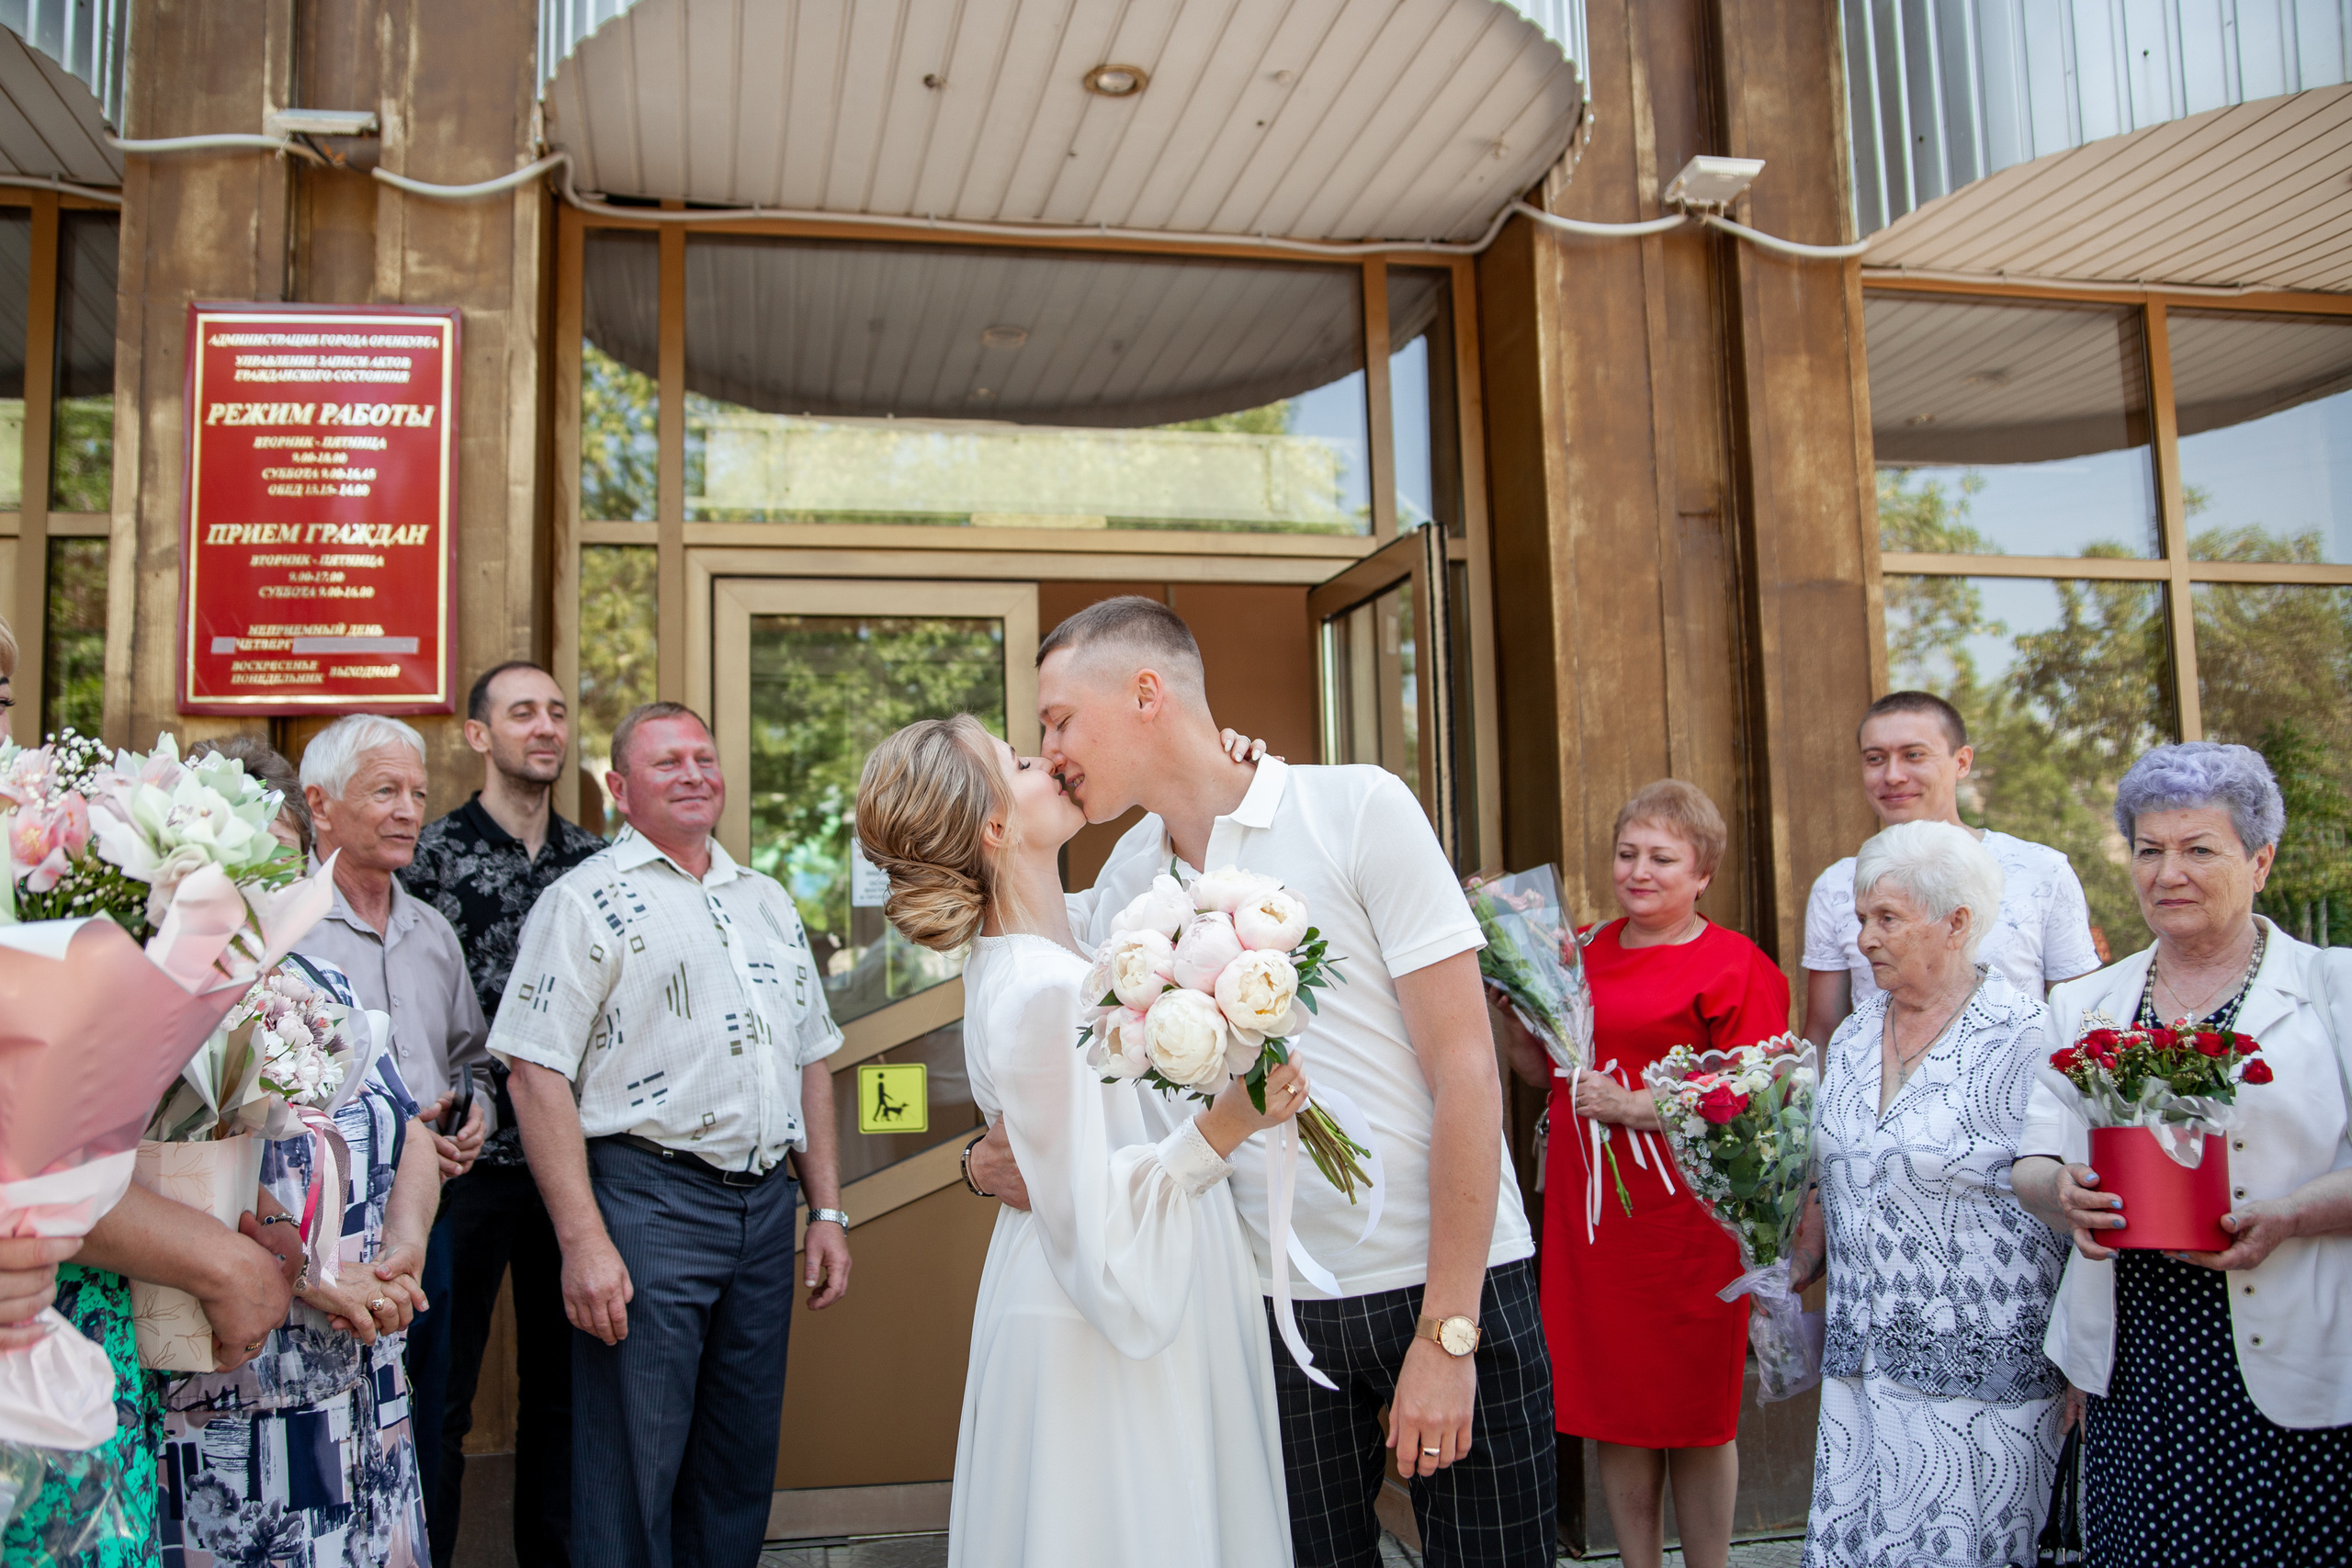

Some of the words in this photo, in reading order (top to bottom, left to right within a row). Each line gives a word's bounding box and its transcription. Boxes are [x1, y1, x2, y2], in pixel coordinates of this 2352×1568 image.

[208, 333, 319, 347] АДМИНИСТРАЦИЯ
[320, 334, 368, 347] ГОРОДА
[368, 334, 439, 348] ОРЕНБУРГА
[235, 355, 317, 367] УПРАВЛЕНИЕ
[318, 355, 369, 368] ЗАПИСИ
[369, 356, 412, 369] АКТОВ
[234, 369, 333, 382] ГРАЖДАНСКОГО
[334, 369, 411, 383] СОСТОЯНИЯ
[206, 402, 315, 426] РЕЖИМ
[318, 403, 435, 427] РАБОТЫ
[253, 436, 315, 449] ВТОРНИК
[322, 436, 387, 450] ПЯТНИЦА
[262, 468, 319, 480] СУББОТА
[267, 483, 303, 496] ОБЕД
[205, 524, 302, 545] ПРИЕМ
[303, 524, 430, 547] ГРАЖДАН
[250, 554, 311, 567] ВТОРНИК
[319, 554, 385, 568] ПЯТНИЦА
[258, 585, 317, 598] СУББОТА
[248, 623, 346, 637] НЕПРИЕМНЫЙ
[346, 625, 385, 637] ДЕНЬ
[236, 637, 293, 651] ЧЕТВЕРГ
[232, 660, 320, 671] ВОСКРЕСЕНЬЕ
[329, 664, 401, 678] ВЫХОДНОЙ
[231, 672, 324, 685] ПОНЕДЕЛЬНИК
